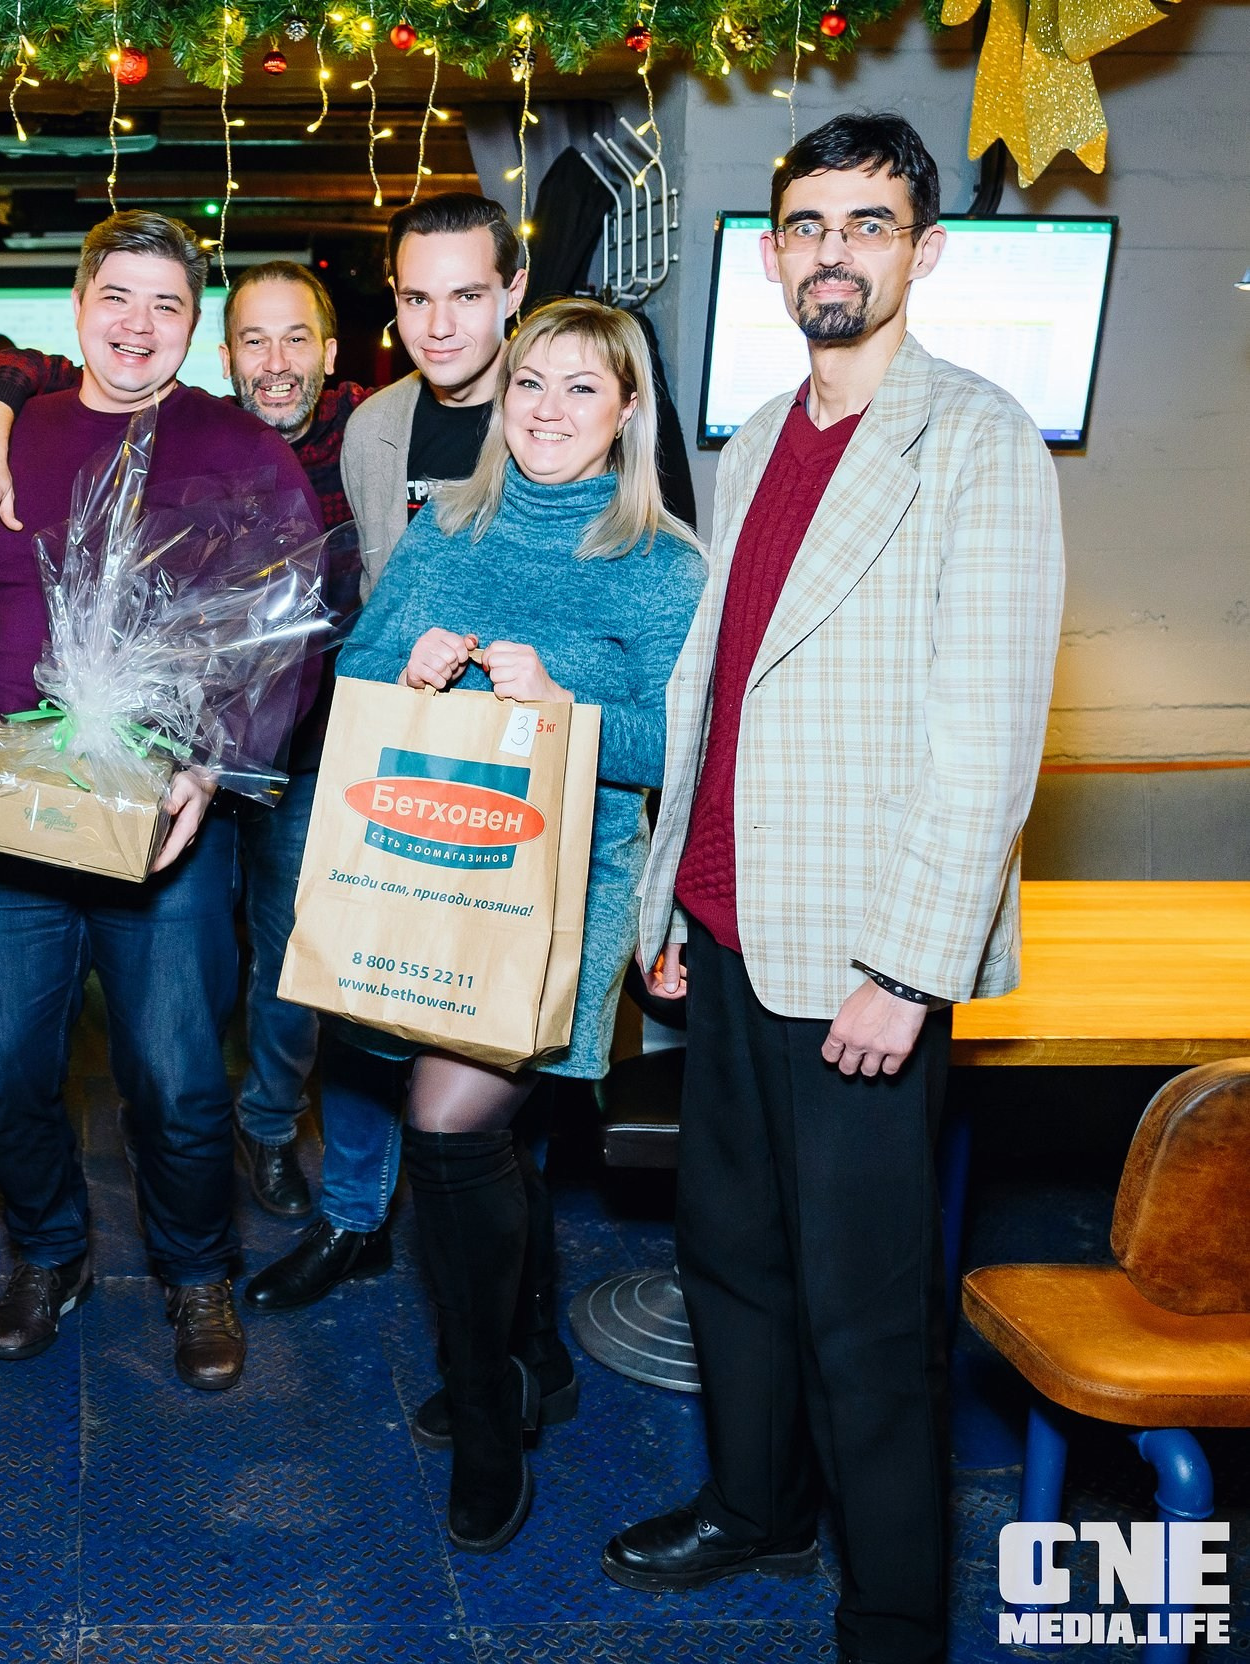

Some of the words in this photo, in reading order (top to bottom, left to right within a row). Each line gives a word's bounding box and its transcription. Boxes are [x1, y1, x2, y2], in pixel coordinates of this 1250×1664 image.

[511, 715, 530, 746] 3
[546, 723, 557, 733] кг
[371, 784, 524, 833] Бетховен
[371, 831, 401, 848] СЕТЬ
[406, 844, 508, 863] ЗООМАГАЗИНОВ
[328, 868, 378, 889] Заходи
[381, 882, 410, 897] сам,
[412, 887, 472, 908] приводи
[473, 897, 534, 917] хозяина!
[352, 952, 363, 965] 8
[366, 955, 396, 972] 800
[399, 961, 430, 979] 555
[432, 969, 454, 985] 22
[458, 973, 474, 989] 11
[338, 977, 477, 1016] www.bethowen.ru
